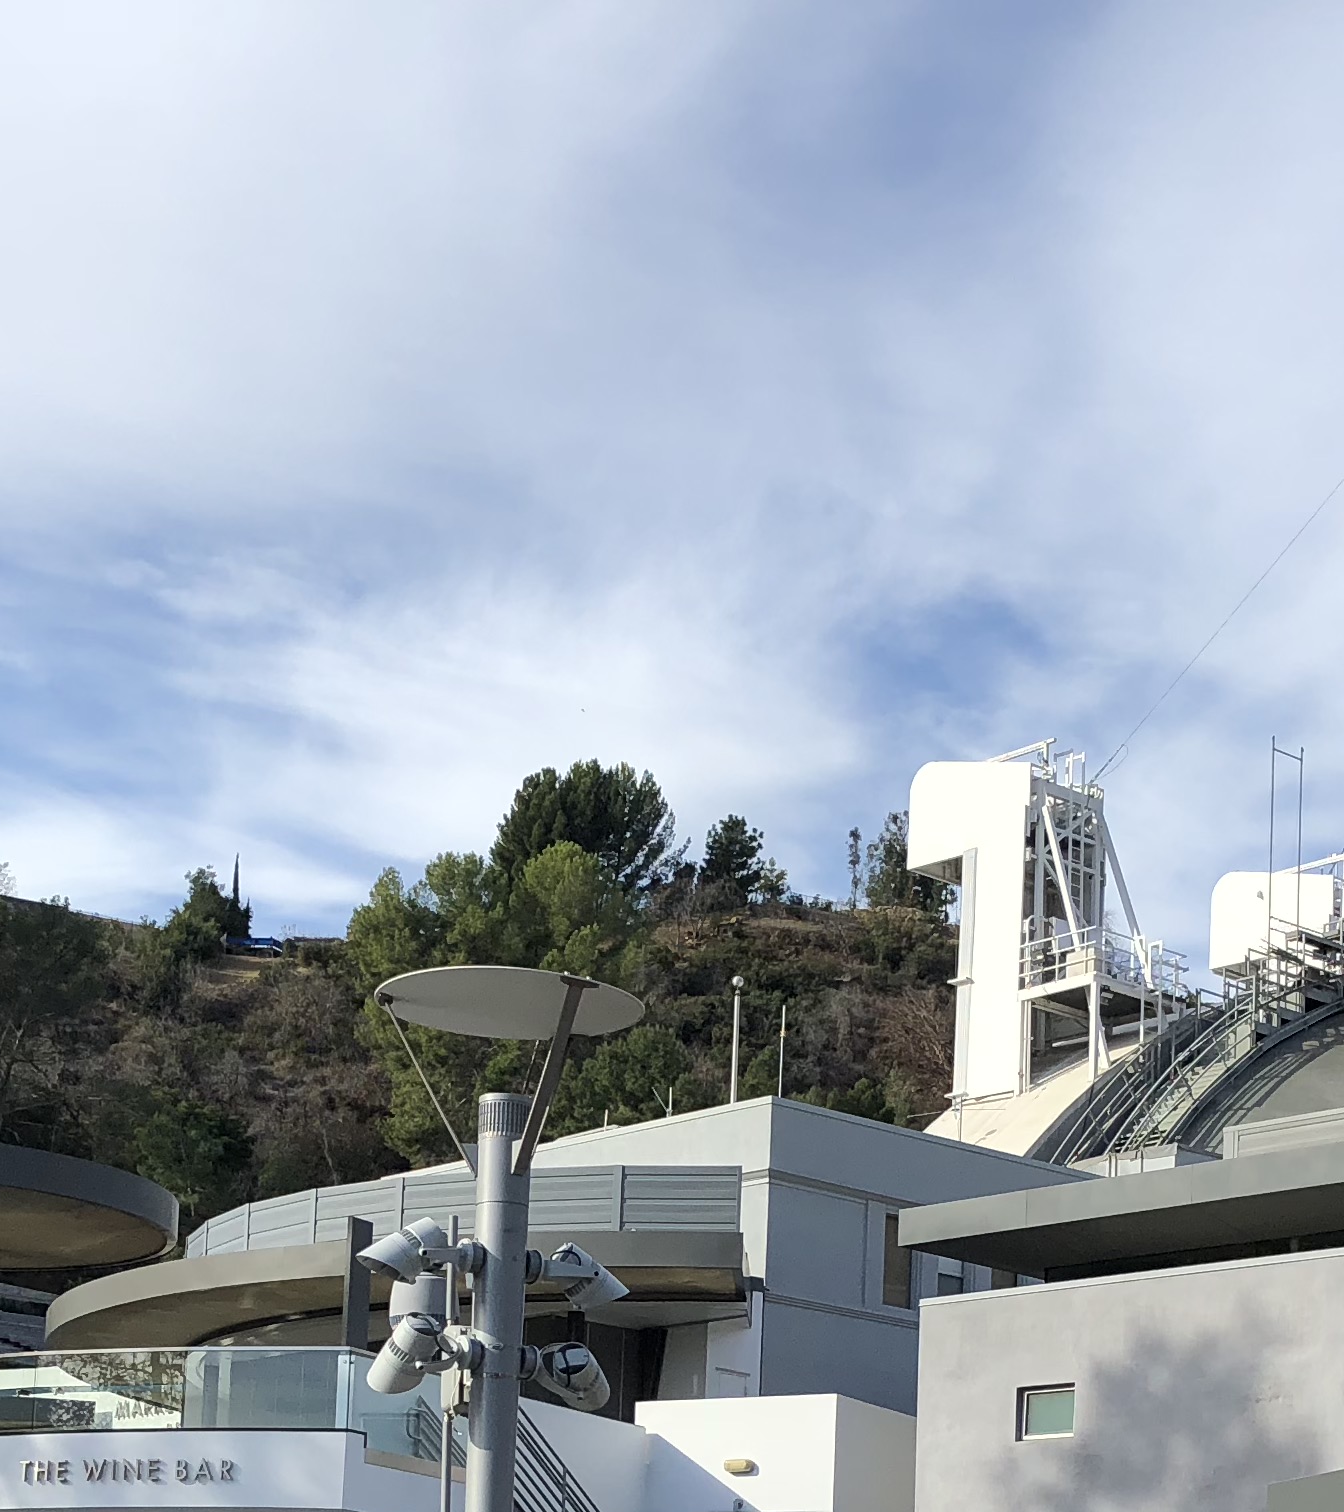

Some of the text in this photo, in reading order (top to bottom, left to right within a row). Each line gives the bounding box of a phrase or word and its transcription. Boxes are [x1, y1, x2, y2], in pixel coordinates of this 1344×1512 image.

[19, 1457, 235, 1483] THE WINE BAR
